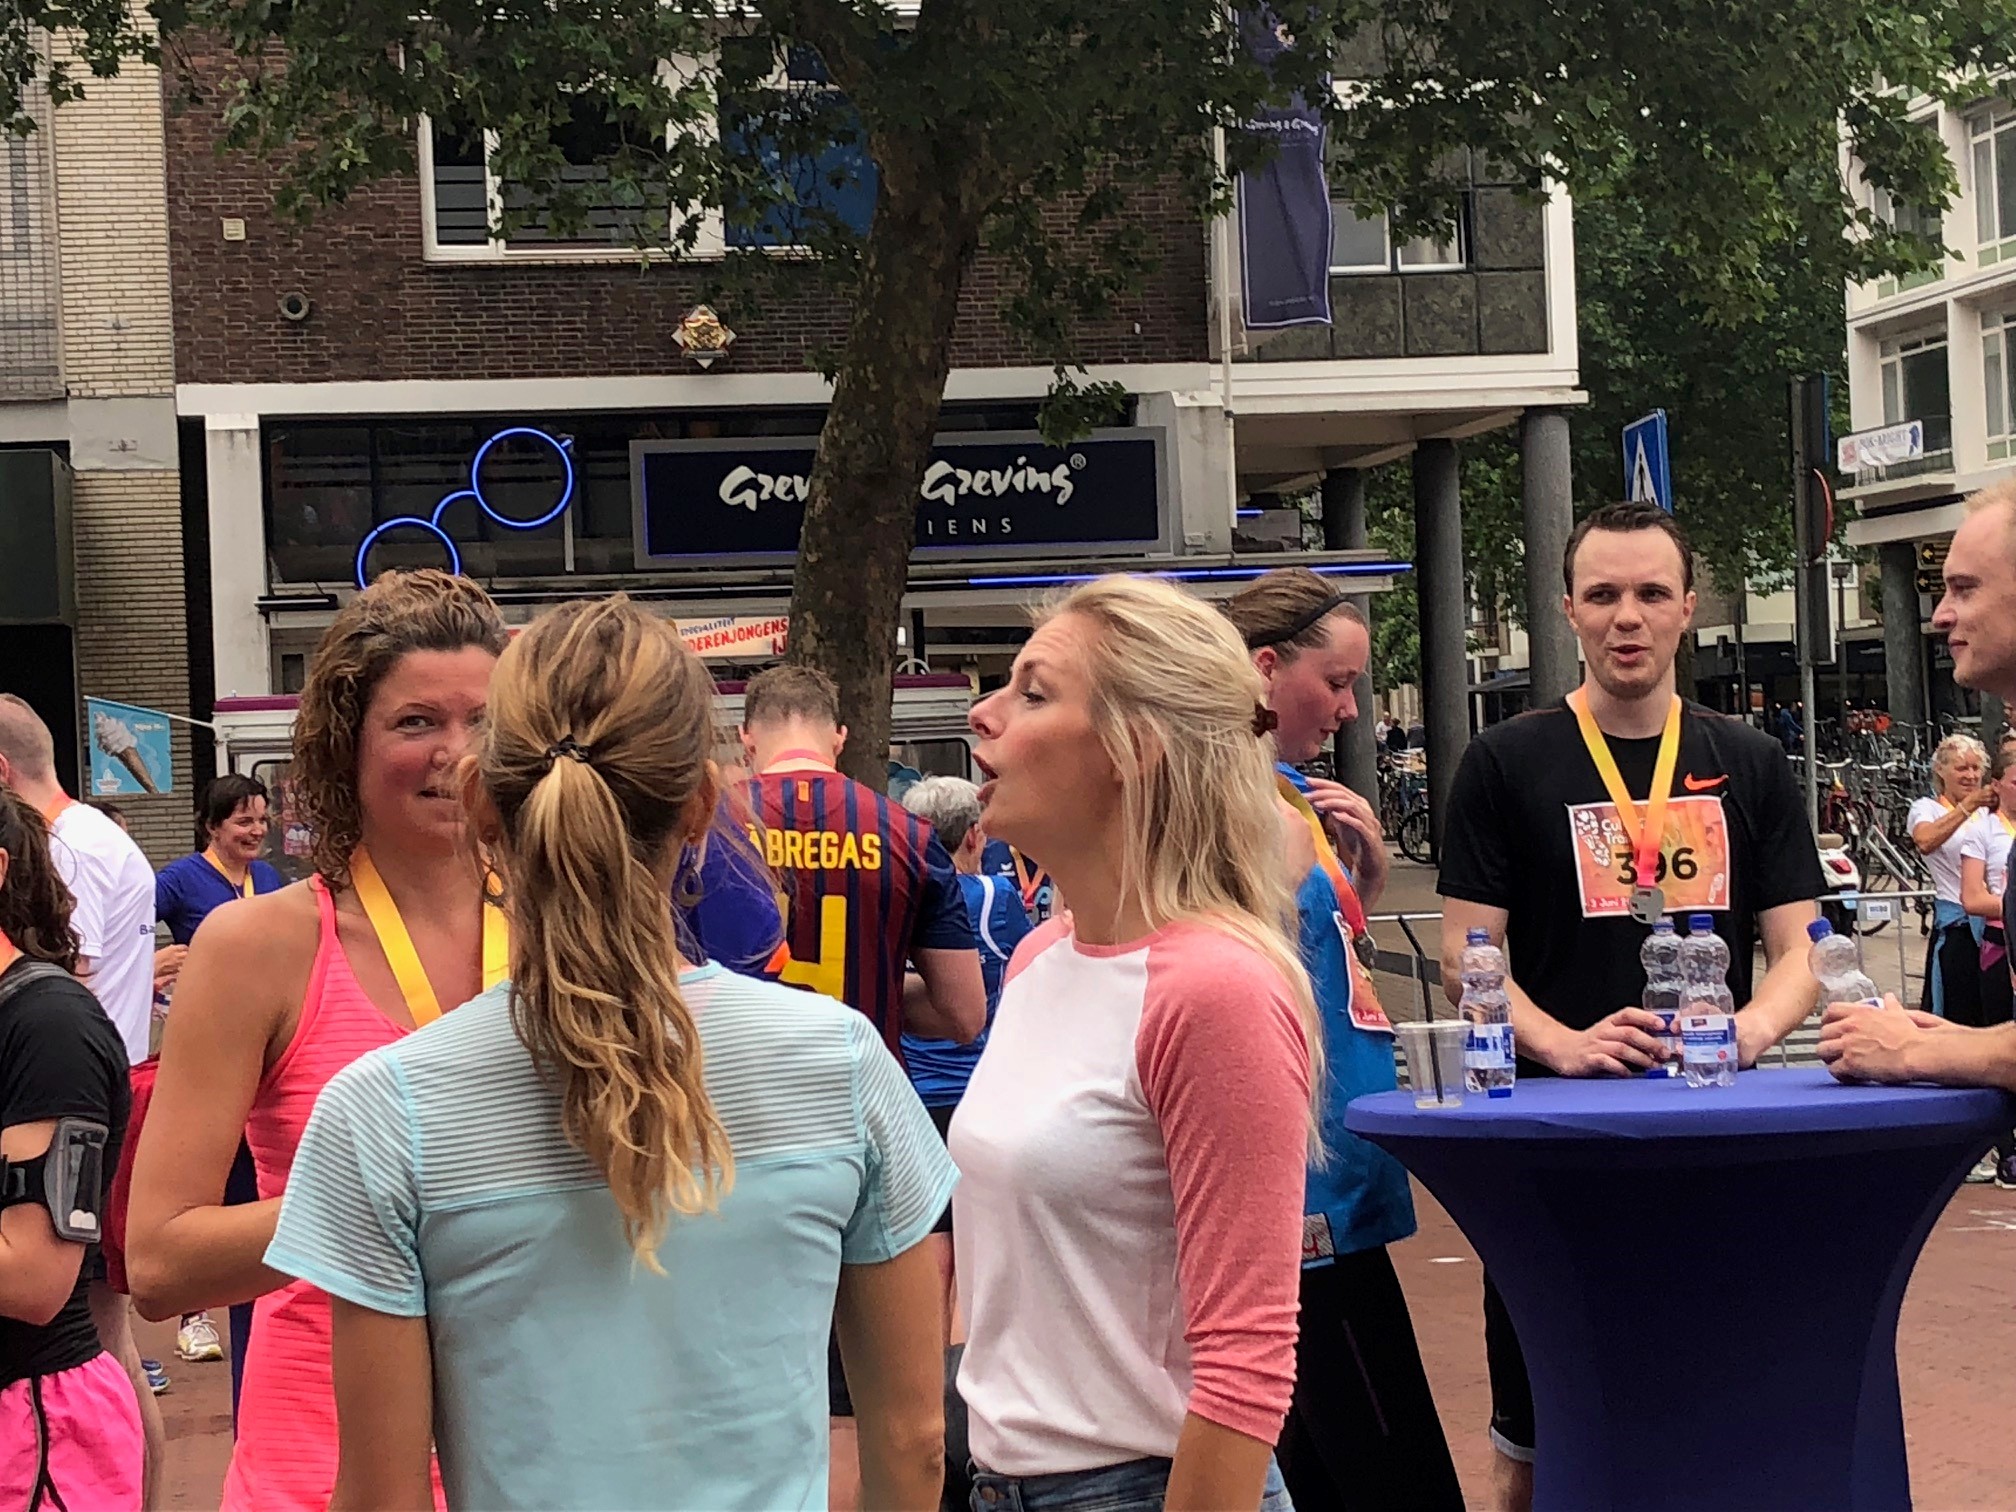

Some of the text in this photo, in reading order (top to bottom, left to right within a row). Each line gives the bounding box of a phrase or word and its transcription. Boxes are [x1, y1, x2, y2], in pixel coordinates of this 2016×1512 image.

[719, 465, 812, 511] Grev
[927, 517, 1012, 535] IENS
[772, 634, 789, 655] IJ
